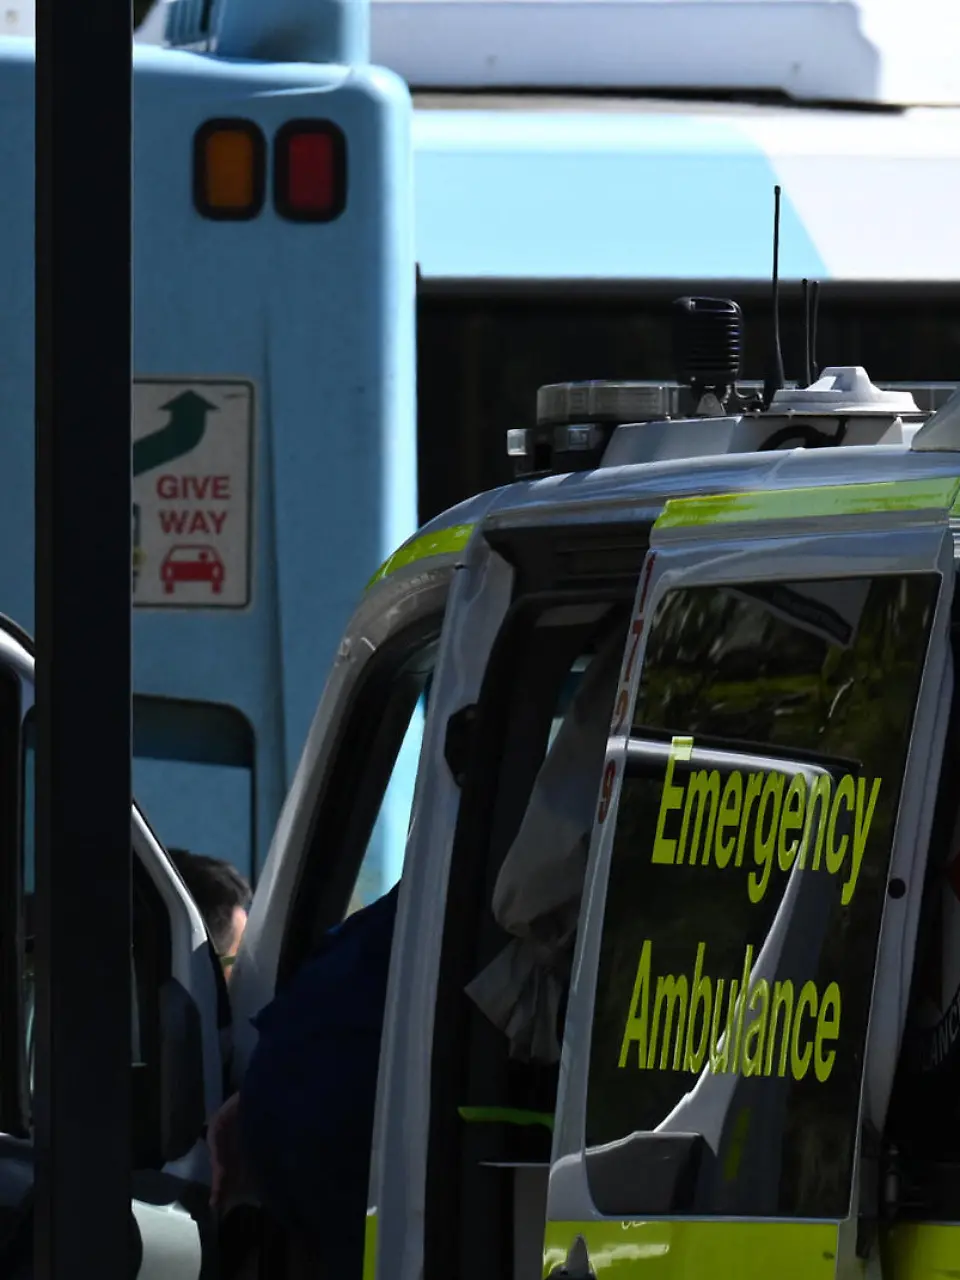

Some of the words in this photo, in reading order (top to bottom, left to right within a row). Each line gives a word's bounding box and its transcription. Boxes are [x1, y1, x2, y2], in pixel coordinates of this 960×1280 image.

[156, 474, 231, 500] GIVE
[159, 509, 228, 535] WAY
[651, 736, 882, 905] Emergency
[618, 939, 841, 1082] Ambulance
